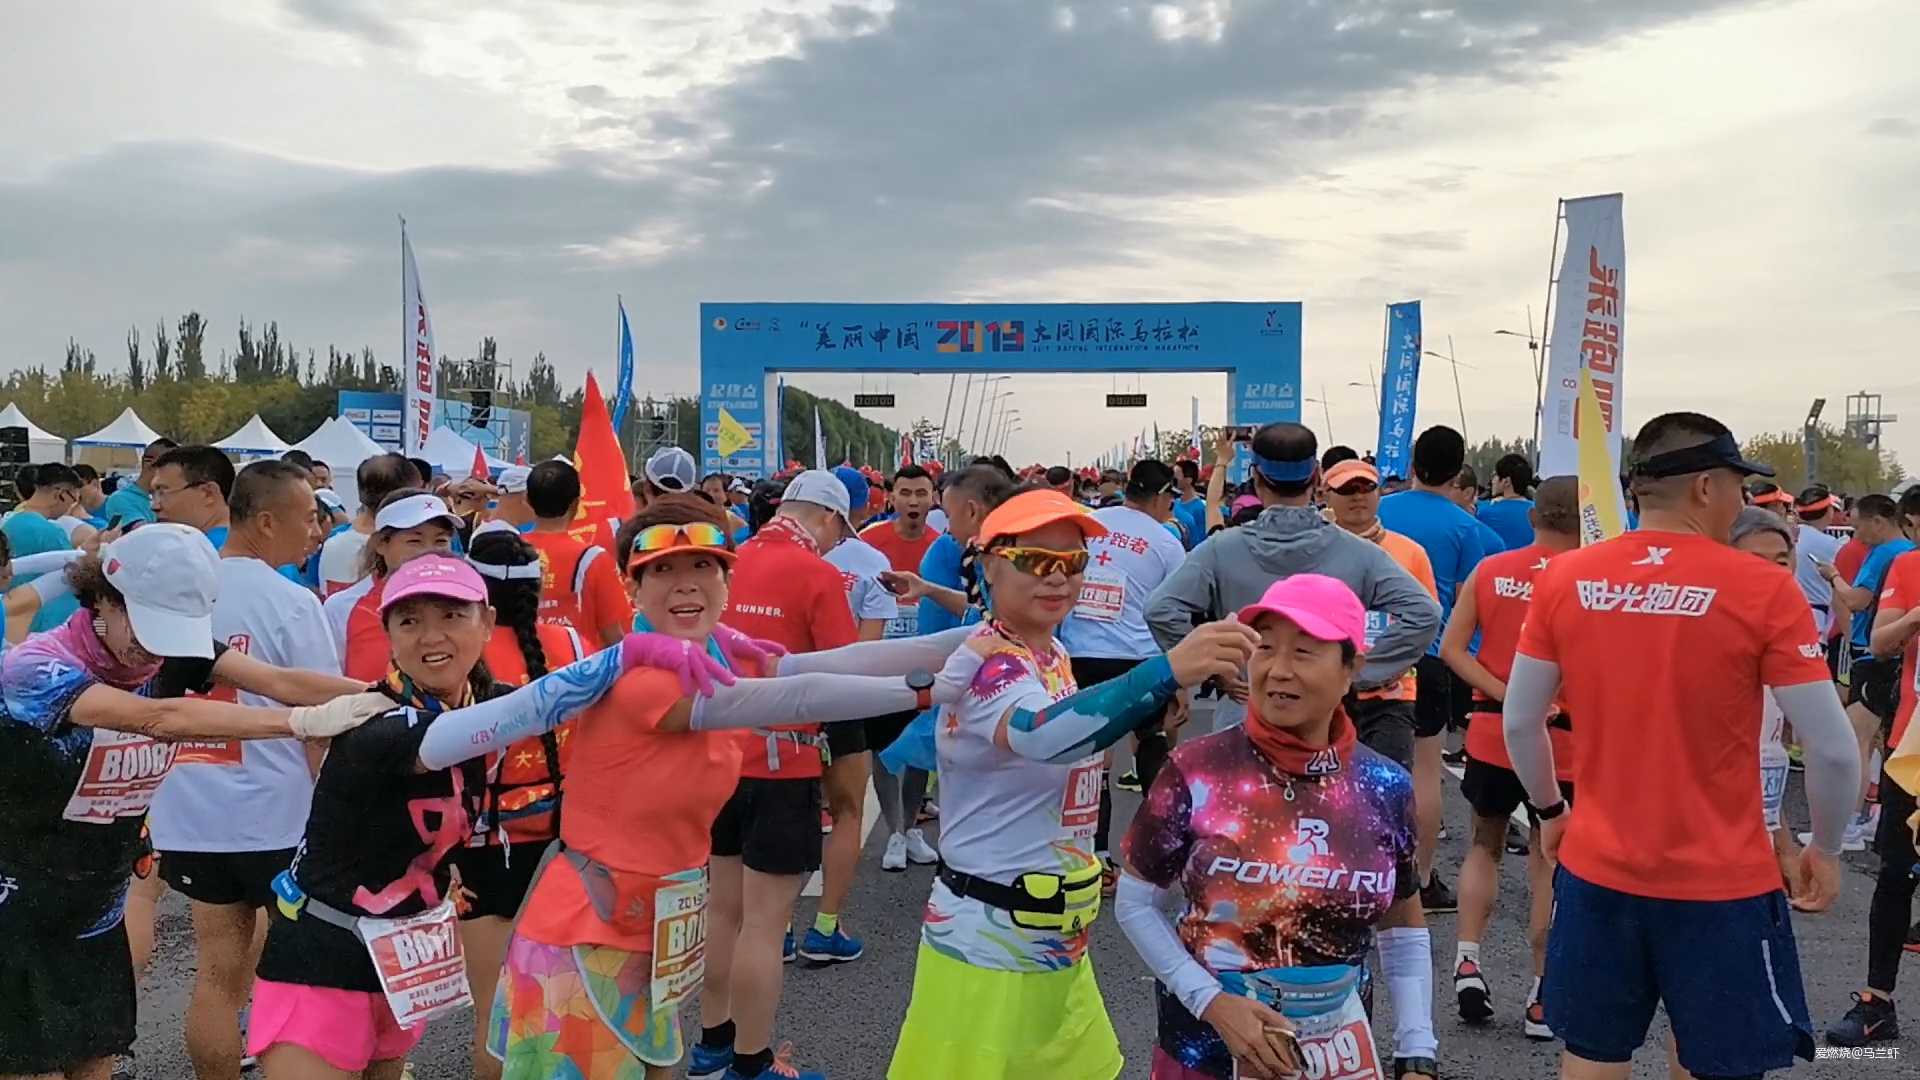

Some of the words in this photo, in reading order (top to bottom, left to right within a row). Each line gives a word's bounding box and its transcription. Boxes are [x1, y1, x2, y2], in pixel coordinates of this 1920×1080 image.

[933, 320, 1024, 352] 2019
[1031, 317, 1200, 343] 大同国际马拉松
[1576, 579, 1717, 617] 阳光跑团
